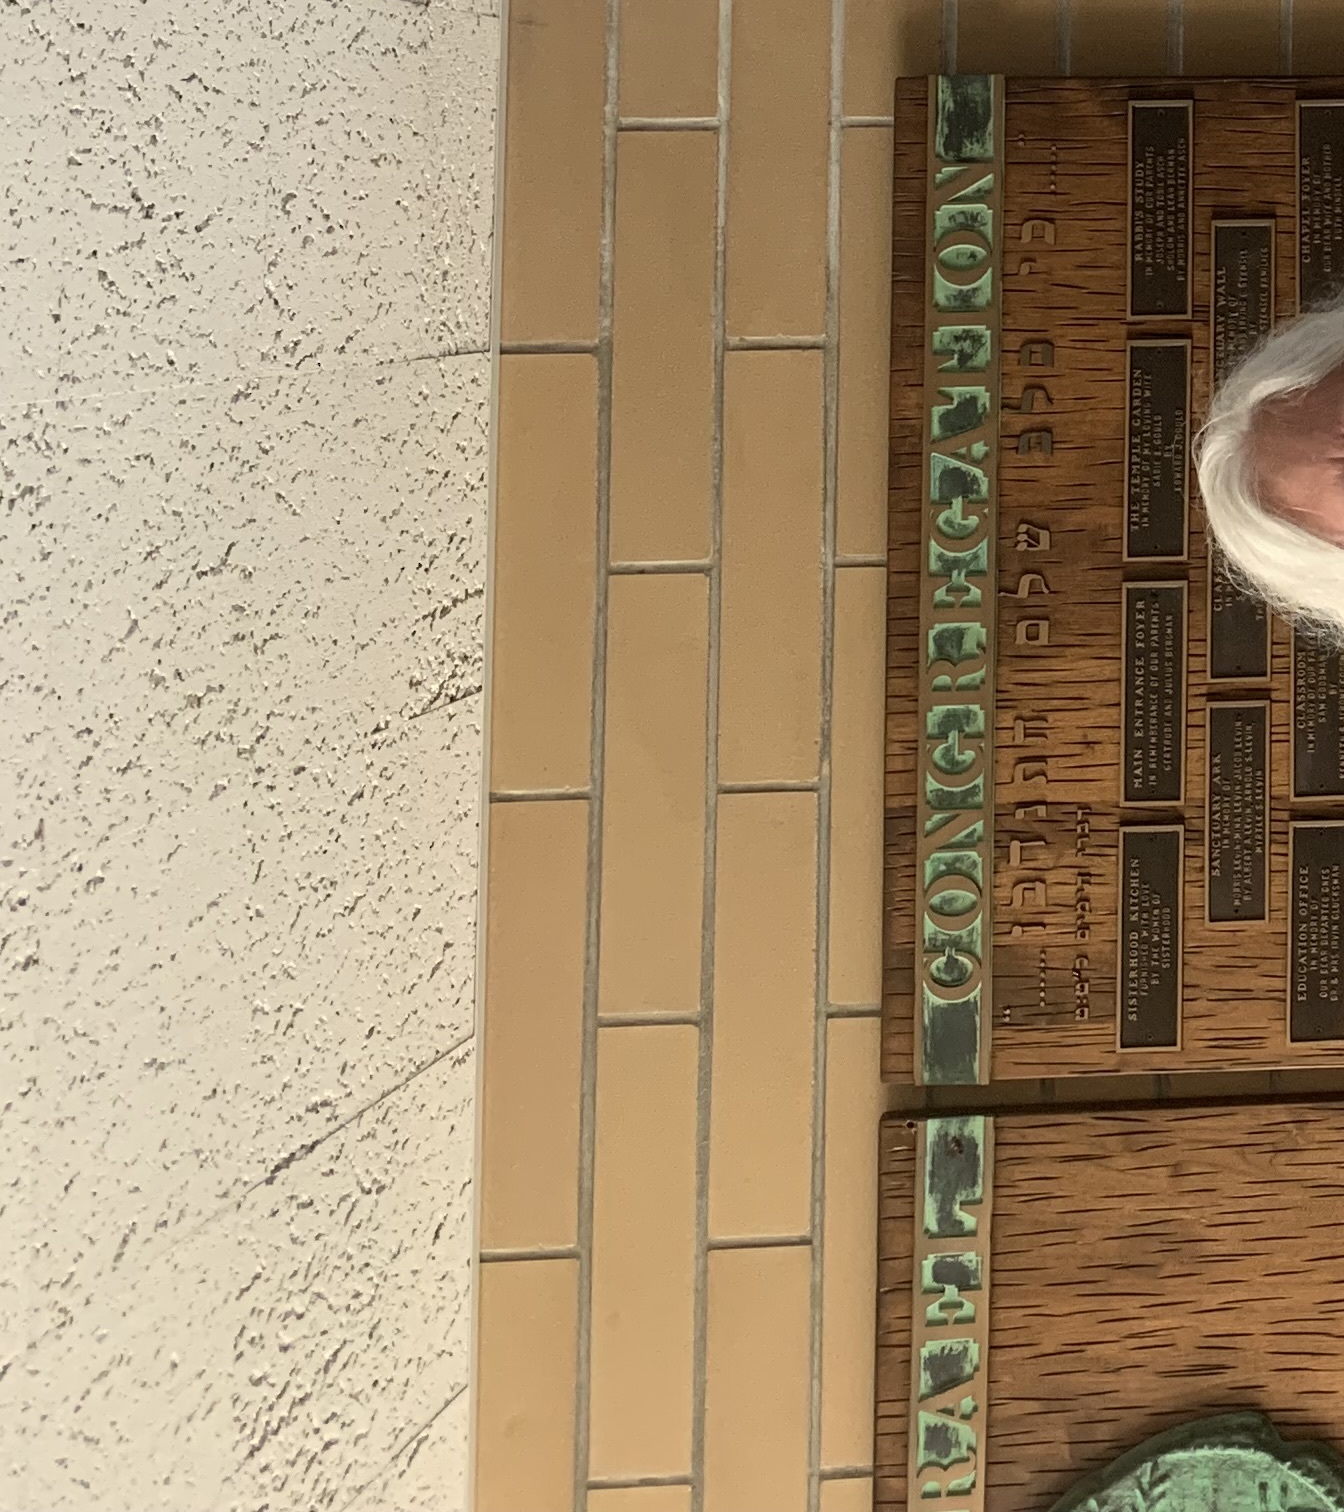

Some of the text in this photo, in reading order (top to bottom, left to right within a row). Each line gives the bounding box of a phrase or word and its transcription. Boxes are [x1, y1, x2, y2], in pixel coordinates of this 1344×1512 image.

[1134, 160, 1144, 261] RABBI'S STUDY
[1216, 266, 1226, 305] WALL
[1130, 368, 1142, 532] THE TEMPLE GARDEN
[919, 159, 996, 1001] CONGREGATION
[1133, 599, 1145, 789] MAIN ENTRANCE FOYER
[1296, 651, 1307, 729] CLASSROOM
[1211, 753, 1222, 877] SANCTUARY ARK
[1128, 858, 1139, 1021] SISTERHOOD KITCHEN
[1162, 907, 1171, 969] SISTERHOOD
[1297, 865, 1309, 1001] EDUCATION OFFICE
